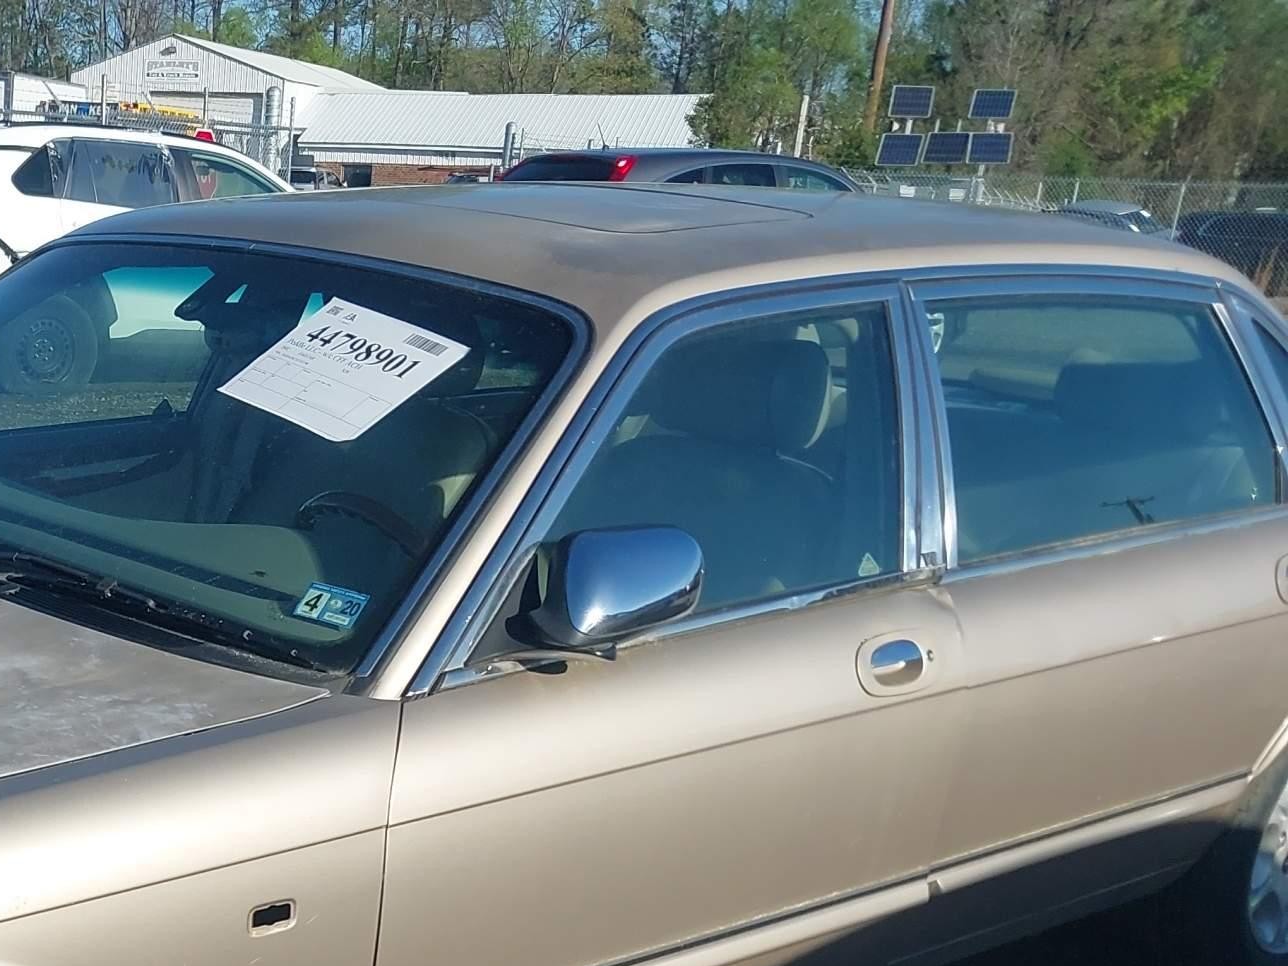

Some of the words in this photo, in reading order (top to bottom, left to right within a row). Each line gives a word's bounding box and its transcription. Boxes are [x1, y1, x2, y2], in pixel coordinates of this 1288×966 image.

[306, 325, 421, 379] 44798901
[304, 593, 324, 612] 4
[340, 600, 361, 617] 20
